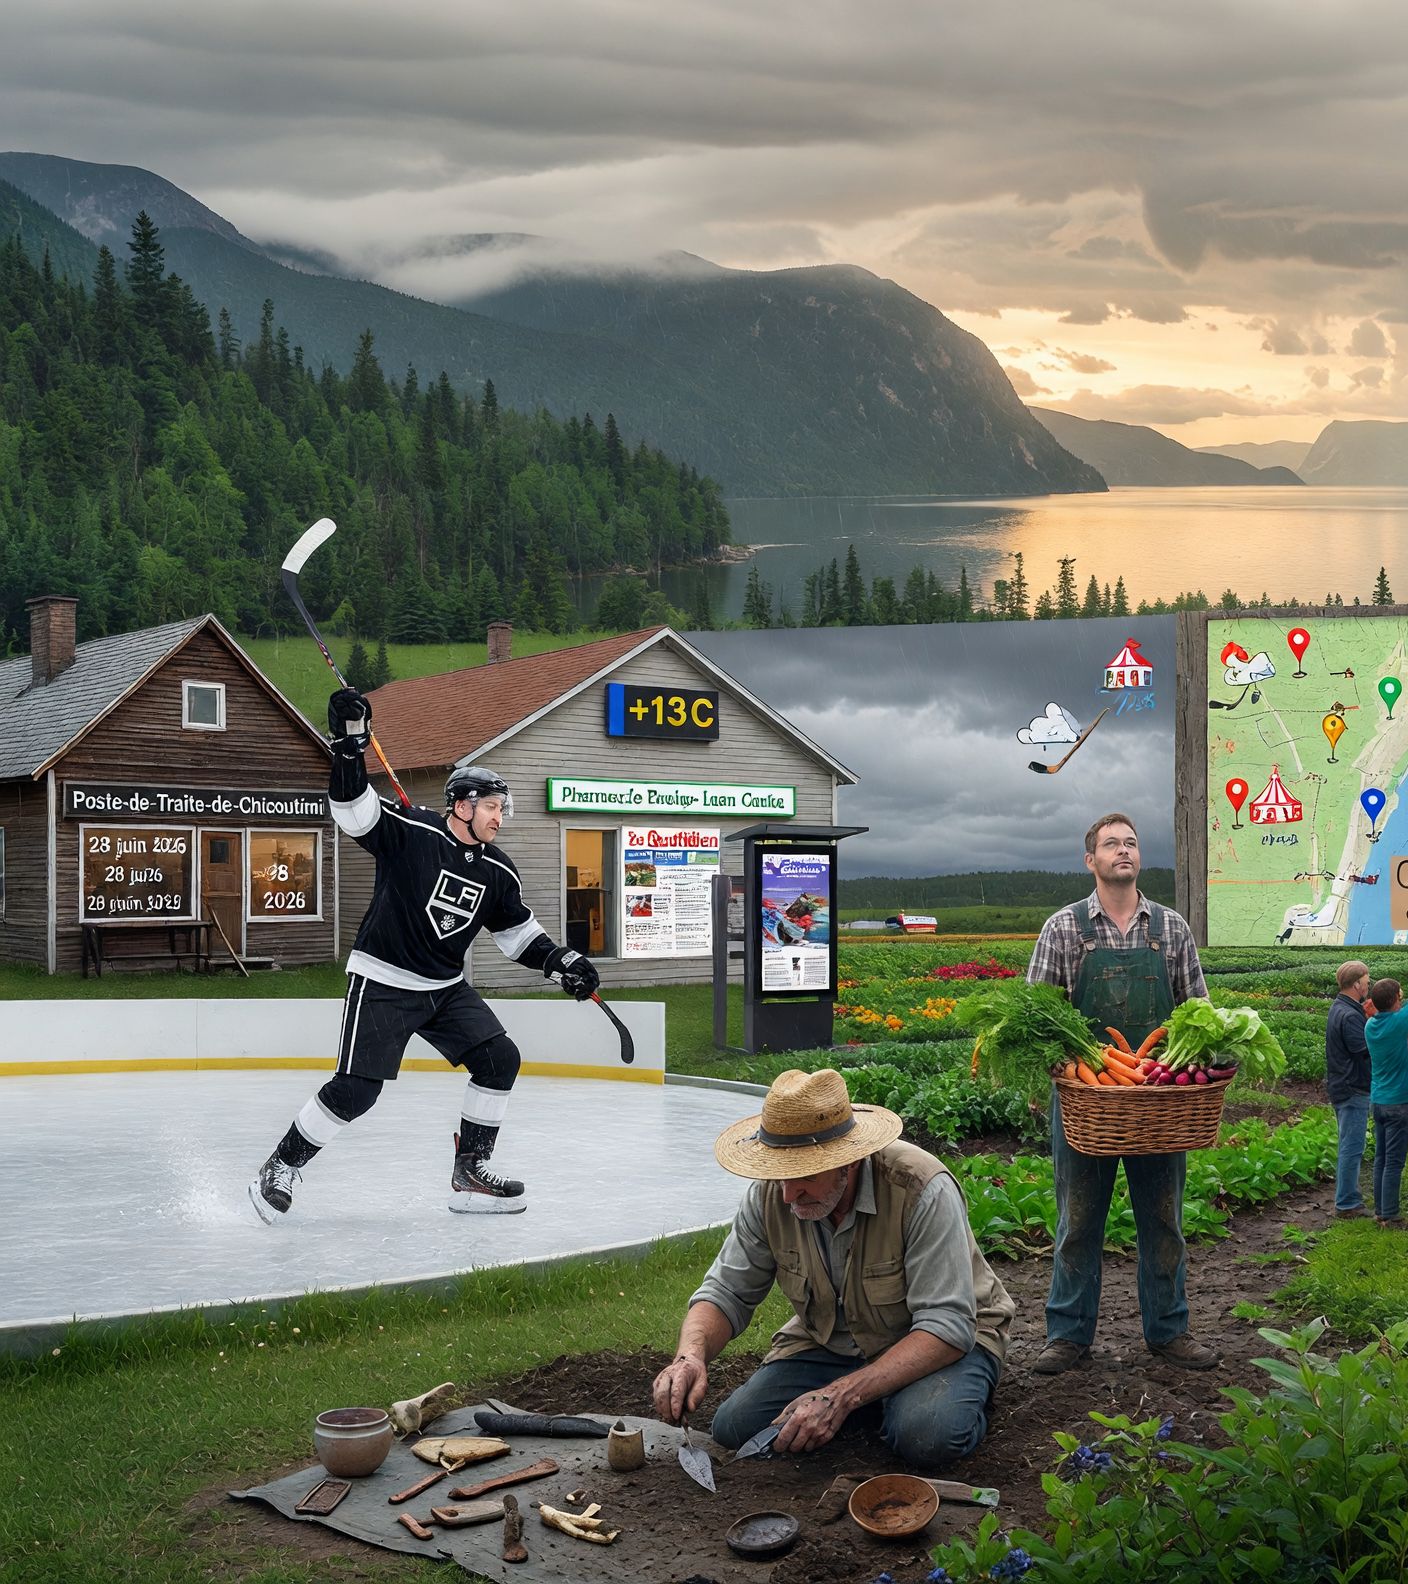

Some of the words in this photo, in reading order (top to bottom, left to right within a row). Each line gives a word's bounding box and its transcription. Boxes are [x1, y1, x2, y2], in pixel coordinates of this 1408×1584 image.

[89, 836, 111, 853] 28
[104, 866, 125, 882] 28
[438, 877, 479, 910] LA
